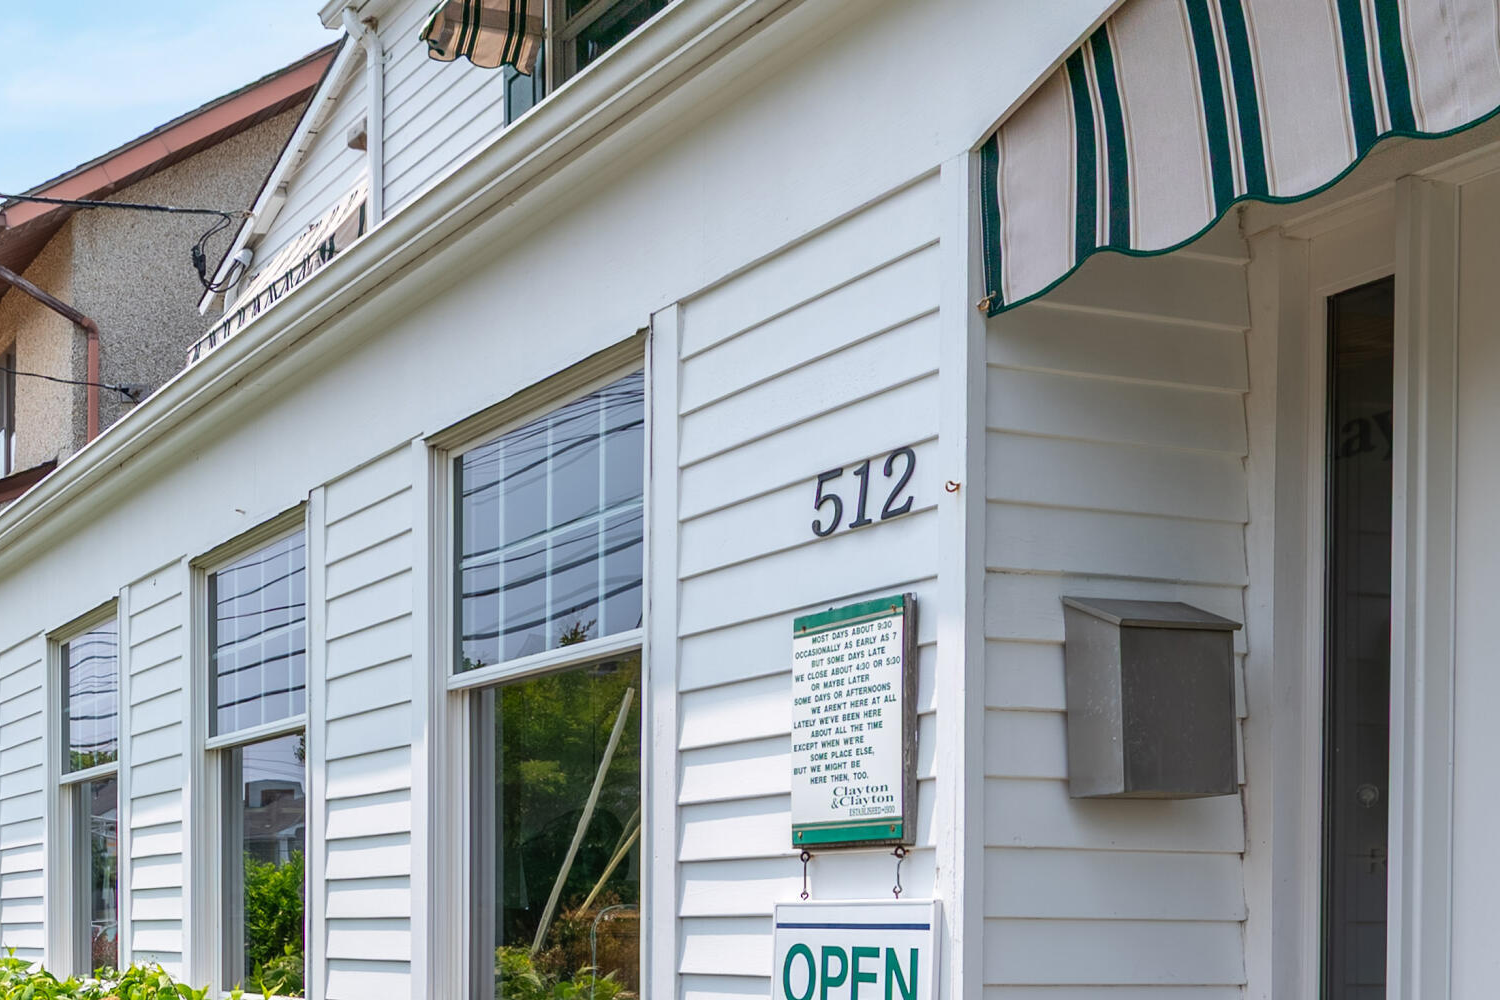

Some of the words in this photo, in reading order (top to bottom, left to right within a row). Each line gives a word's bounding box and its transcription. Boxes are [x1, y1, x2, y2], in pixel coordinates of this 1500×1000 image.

[812, 446, 916, 537] 512
[812, 635, 828, 644] MOST
[832, 630, 848, 640] DAYS
[852, 625, 873, 635] ABOUT
[878, 620, 892, 630] 9:30
[795, 644, 840, 659] OCCASIONALLY
[845, 641, 852, 649] AS
[857, 636, 876, 647] EARLY
[881, 634, 889, 642] AS
[812, 660, 823, 668] BUT
[828, 655, 844, 664] SOME
[848, 651, 864, 660] DAYS
[868, 647, 885, 656] LATE
[808, 670, 827, 680] CLOSE
[832, 665, 852, 675] ABOUT
[856, 662, 870, 670] 4:30
[874, 660, 882, 668] OR
[887, 656, 900, 665] 5:30
[824, 679, 844, 688] MAYBE
[848, 674, 869, 684] LATER
[795, 696, 811, 706] SOME
[815, 693, 830, 702] DAYS
[834, 691, 842, 699] OR
[846, 682, 891, 697] AFTERNOONS
[812, 706, 820, 714] WE
[850, 698, 868, 707] HERE
[872, 696, 880, 704] AT
[884, 694, 896, 702] ALL
[794, 720, 816, 729] LATELY
[843, 712, 860, 721] BEEN
[864, 709, 882, 718] HERE
[811, 728, 831, 738] ABOUT
[835, 726, 847, 734] ALL
[851, 724, 863, 732] THE
[868, 721, 883, 730] TIME
[794, 742, 818, 752] EXCEPT
[821, 739, 840, 748] WHEN
[811, 753, 827, 761] SOME
[831, 750, 852, 759] PLACE
[794, 767, 807, 775] BUT
[811, 765, 821, 773] WE
[825, 762, 847, 771] MIGHT
[851, 760, 860, 768] BE
[810, 776, 827, 784] HERE
[833, 785, 888, 797] Clayton
